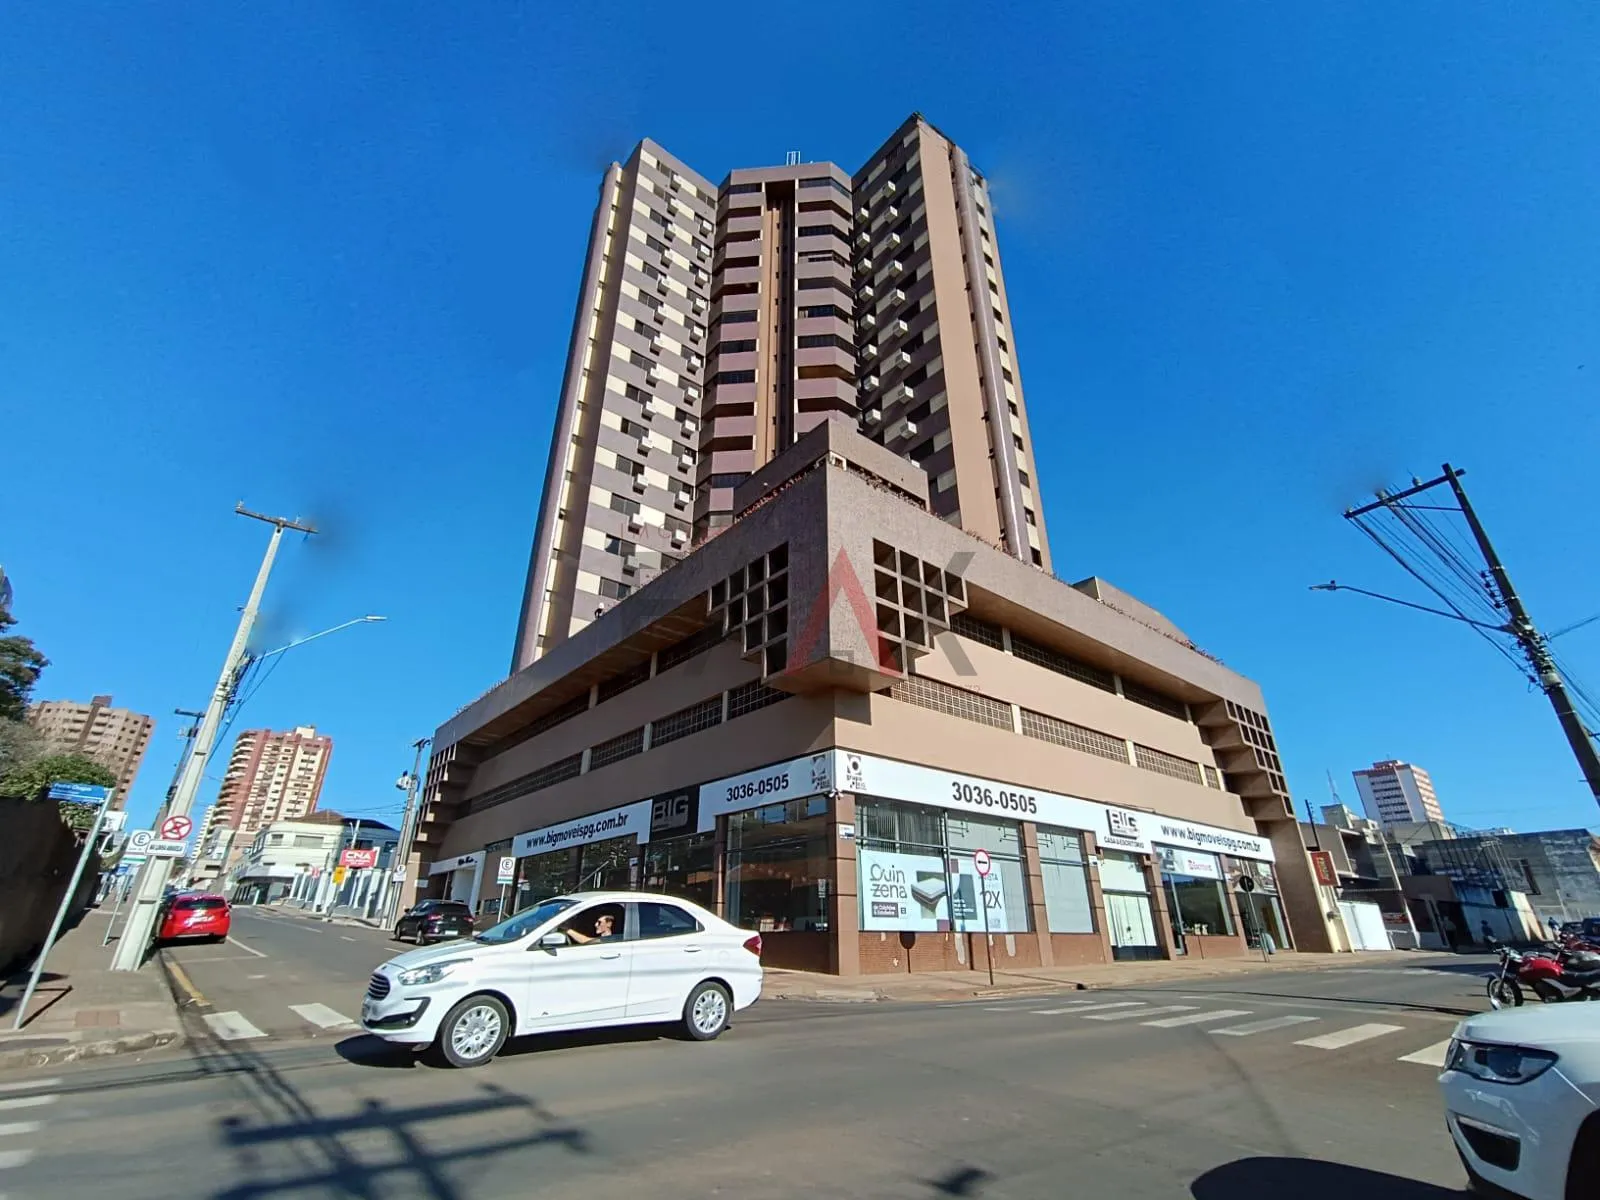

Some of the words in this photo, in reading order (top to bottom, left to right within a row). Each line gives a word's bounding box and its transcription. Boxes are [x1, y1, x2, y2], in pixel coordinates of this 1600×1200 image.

[726, 773, 789, 802] 3036-0505
[951, 781, 1037, 815] 3036-0505
[526, 812, 629, 849] www.bigmoveispg.com.br
[1160, 824, 1261, 852] www.bigmoveispg.com.br
[345, 851, 371, 860] CNA
